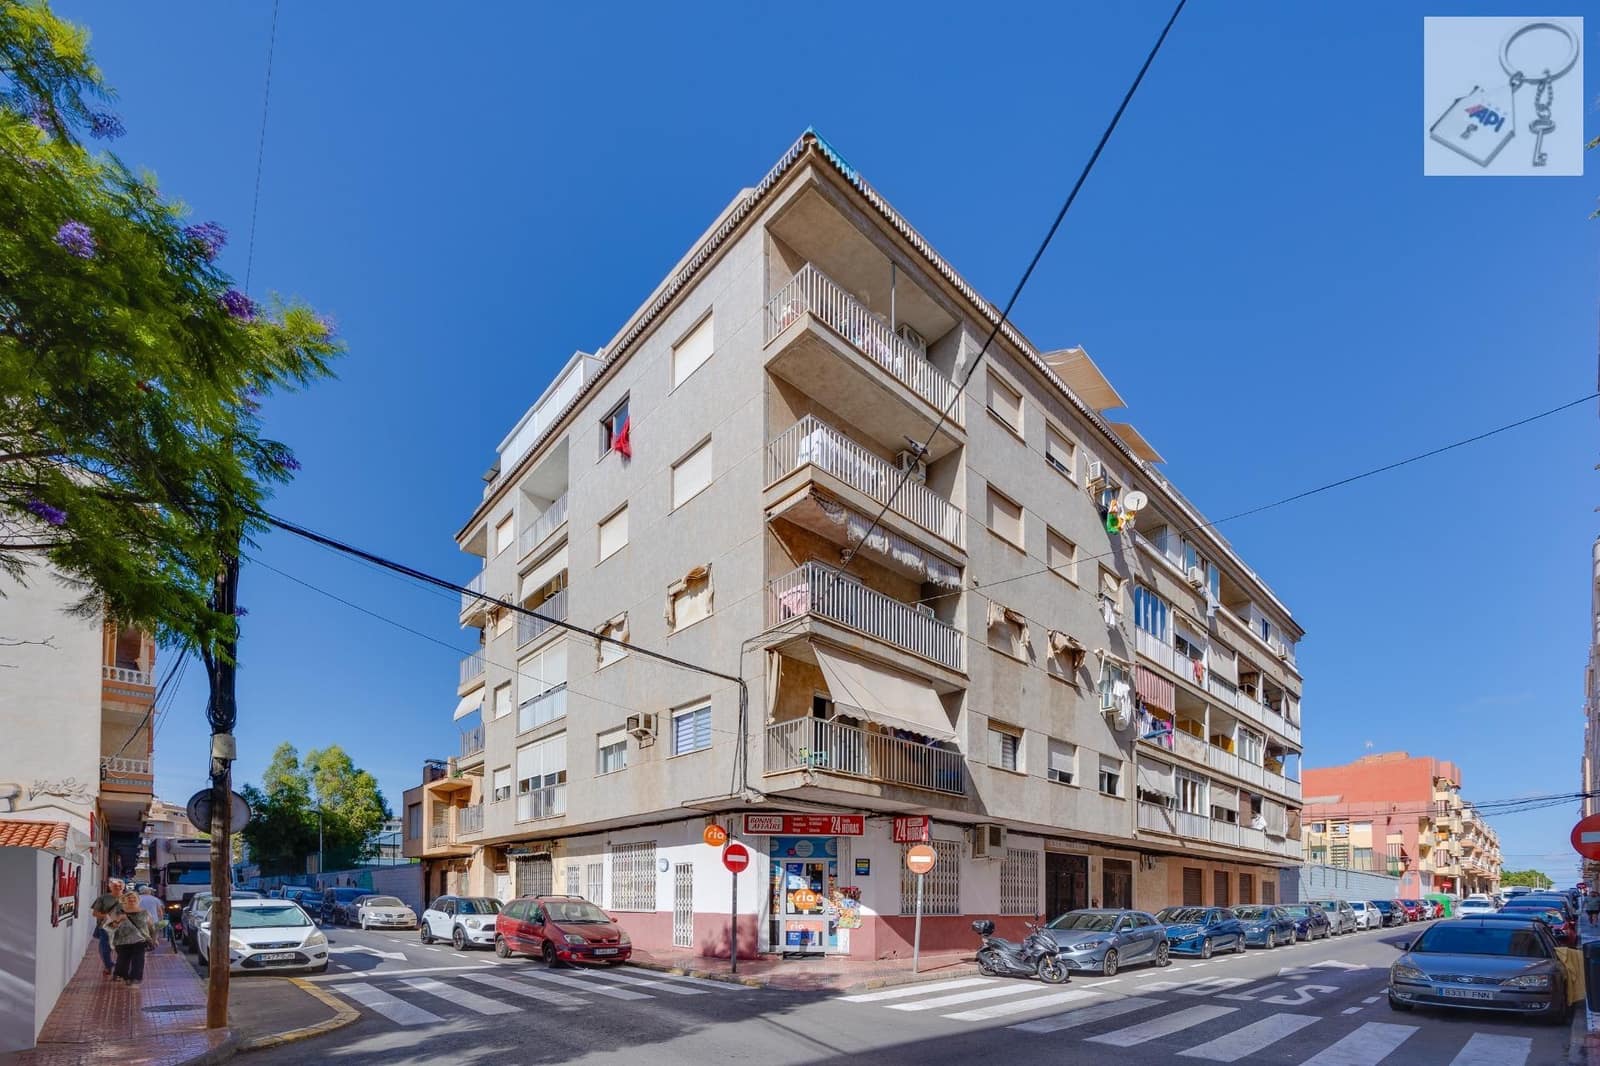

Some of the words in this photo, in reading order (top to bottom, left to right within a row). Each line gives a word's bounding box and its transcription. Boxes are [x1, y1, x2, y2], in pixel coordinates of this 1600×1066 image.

[831, 816, 841, 833] 24
[895, 818, 906, 841] 24
[707, 827, 725, 840] ria
[796, 890, 815, 902] ria
[790, 921, 805, 931] ria
